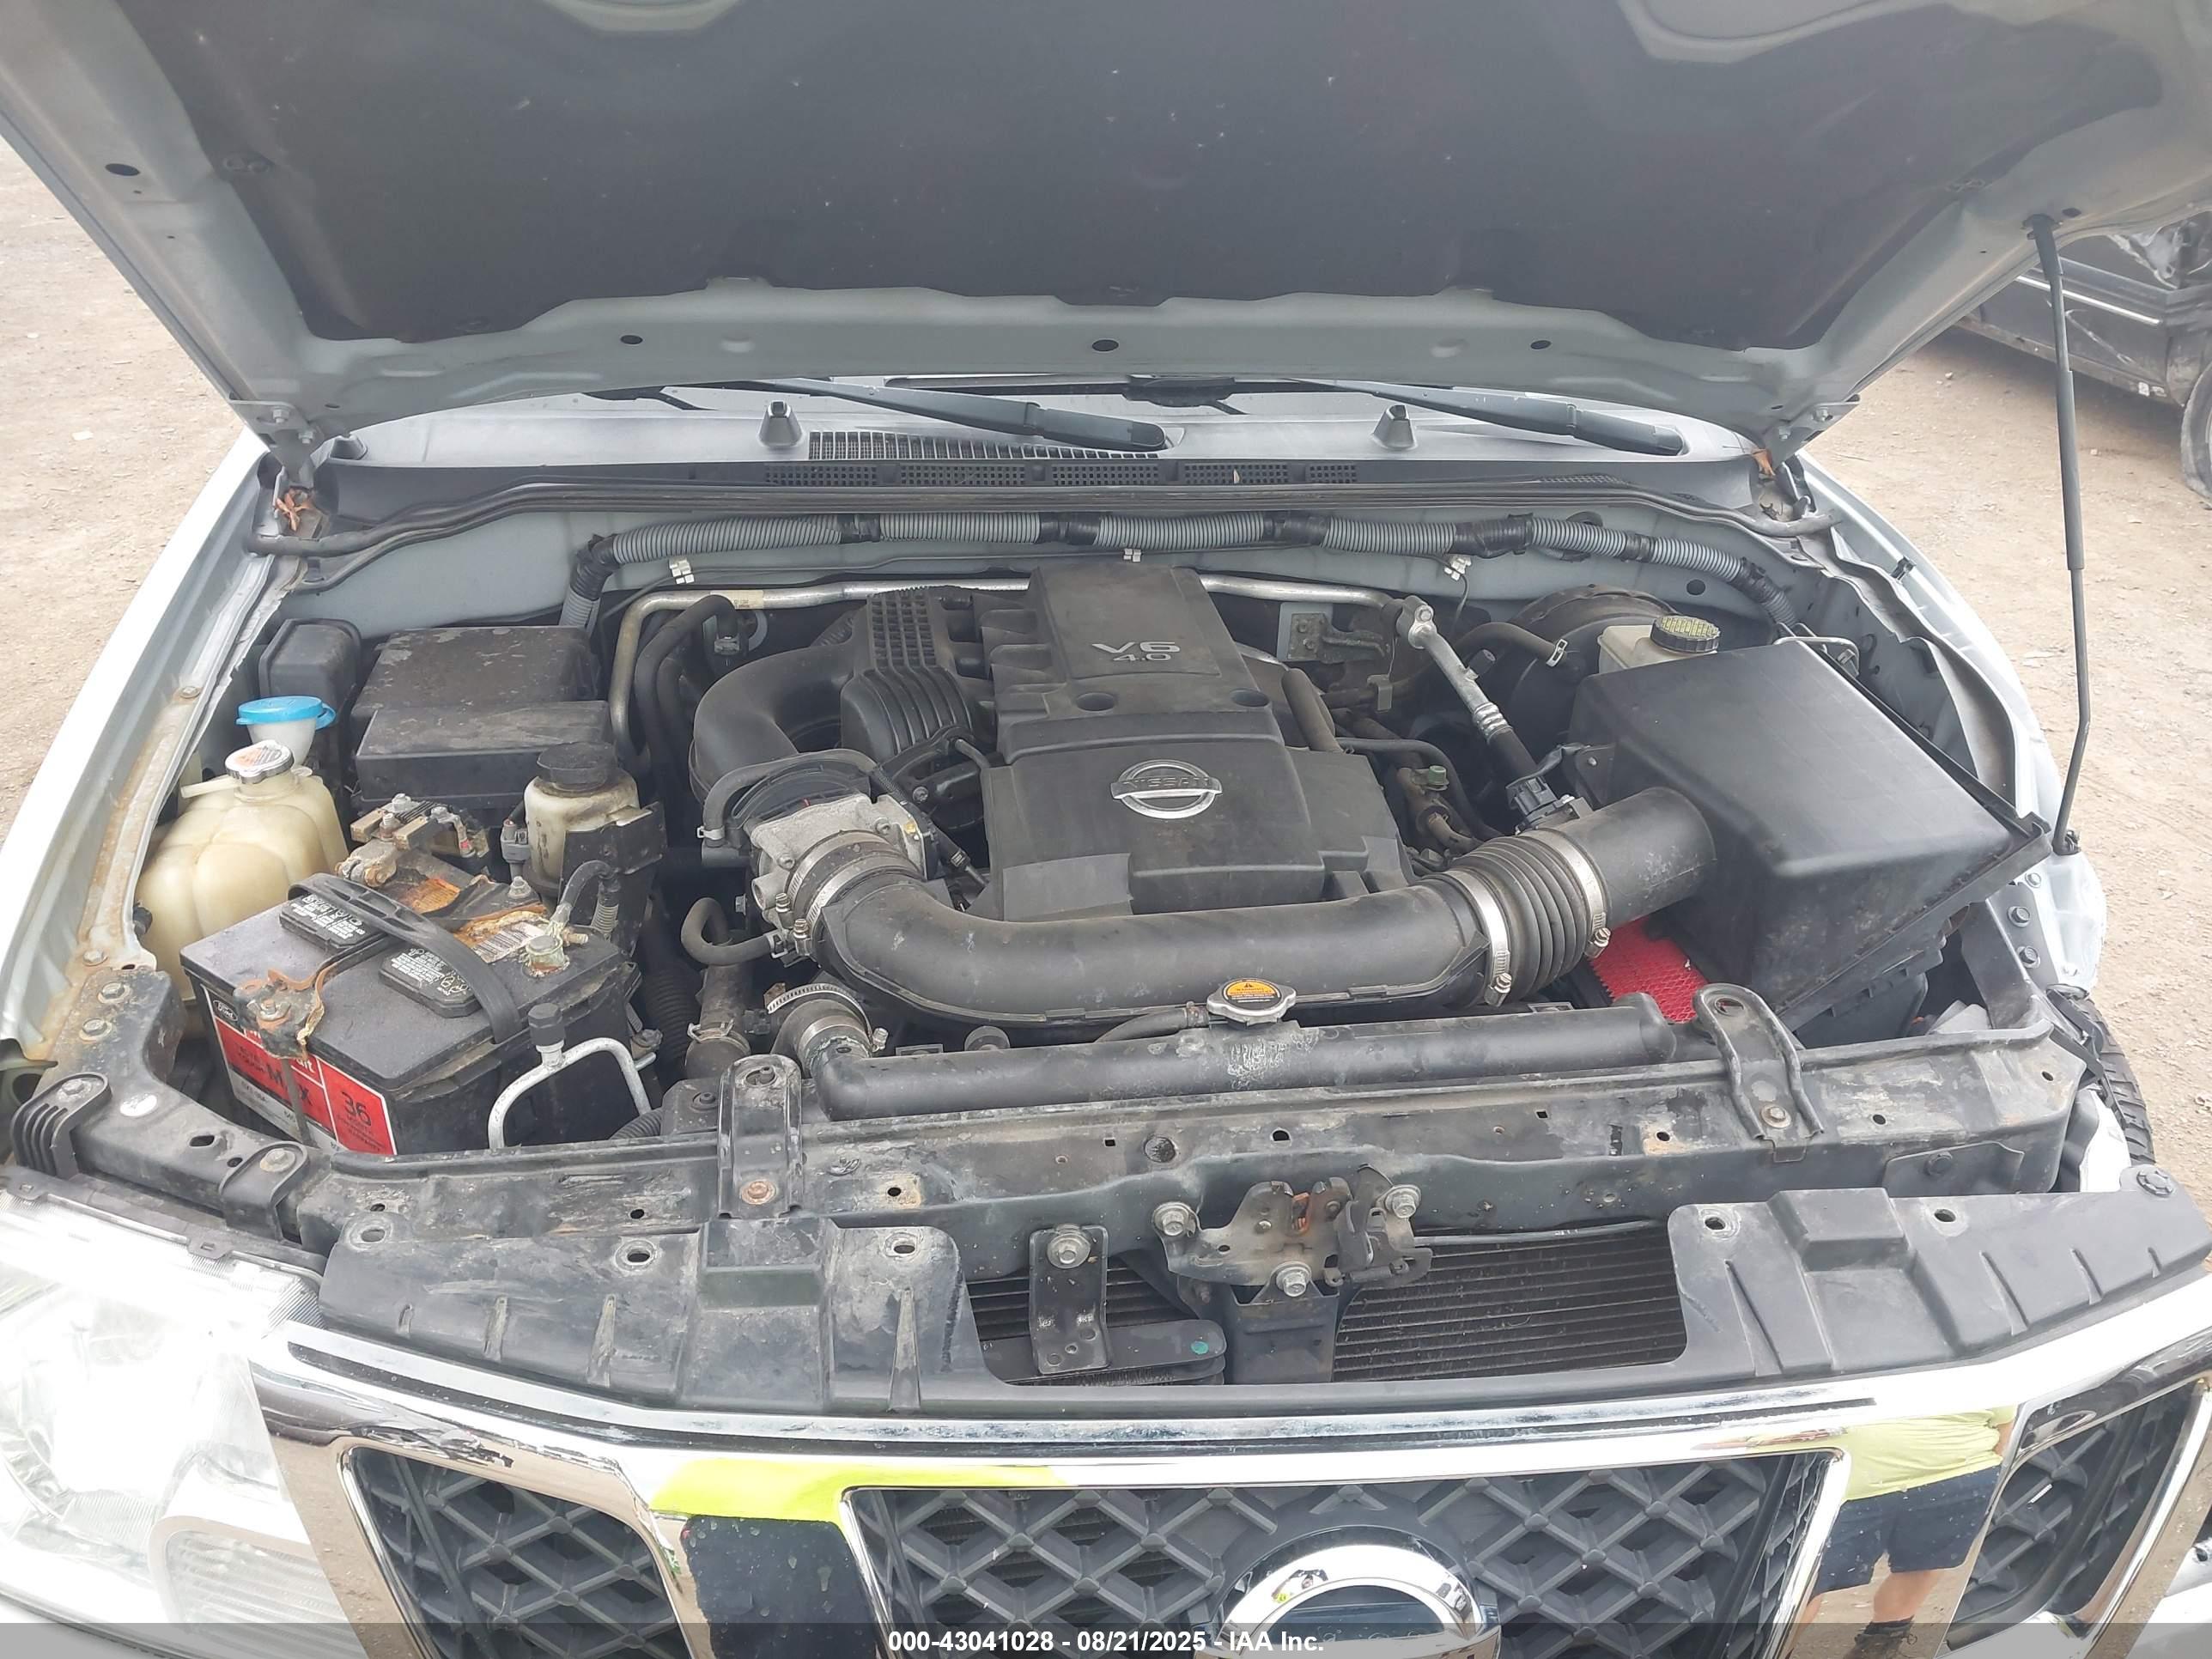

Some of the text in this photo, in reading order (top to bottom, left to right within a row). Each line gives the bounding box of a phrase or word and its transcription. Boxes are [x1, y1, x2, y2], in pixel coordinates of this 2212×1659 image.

[1091, 641, 1181, 653] V6
[1113, 653, 1171, 661] 4.0
[266, 1063, 313, 1107] MX
[341, 1091, 372, 1127] 36
